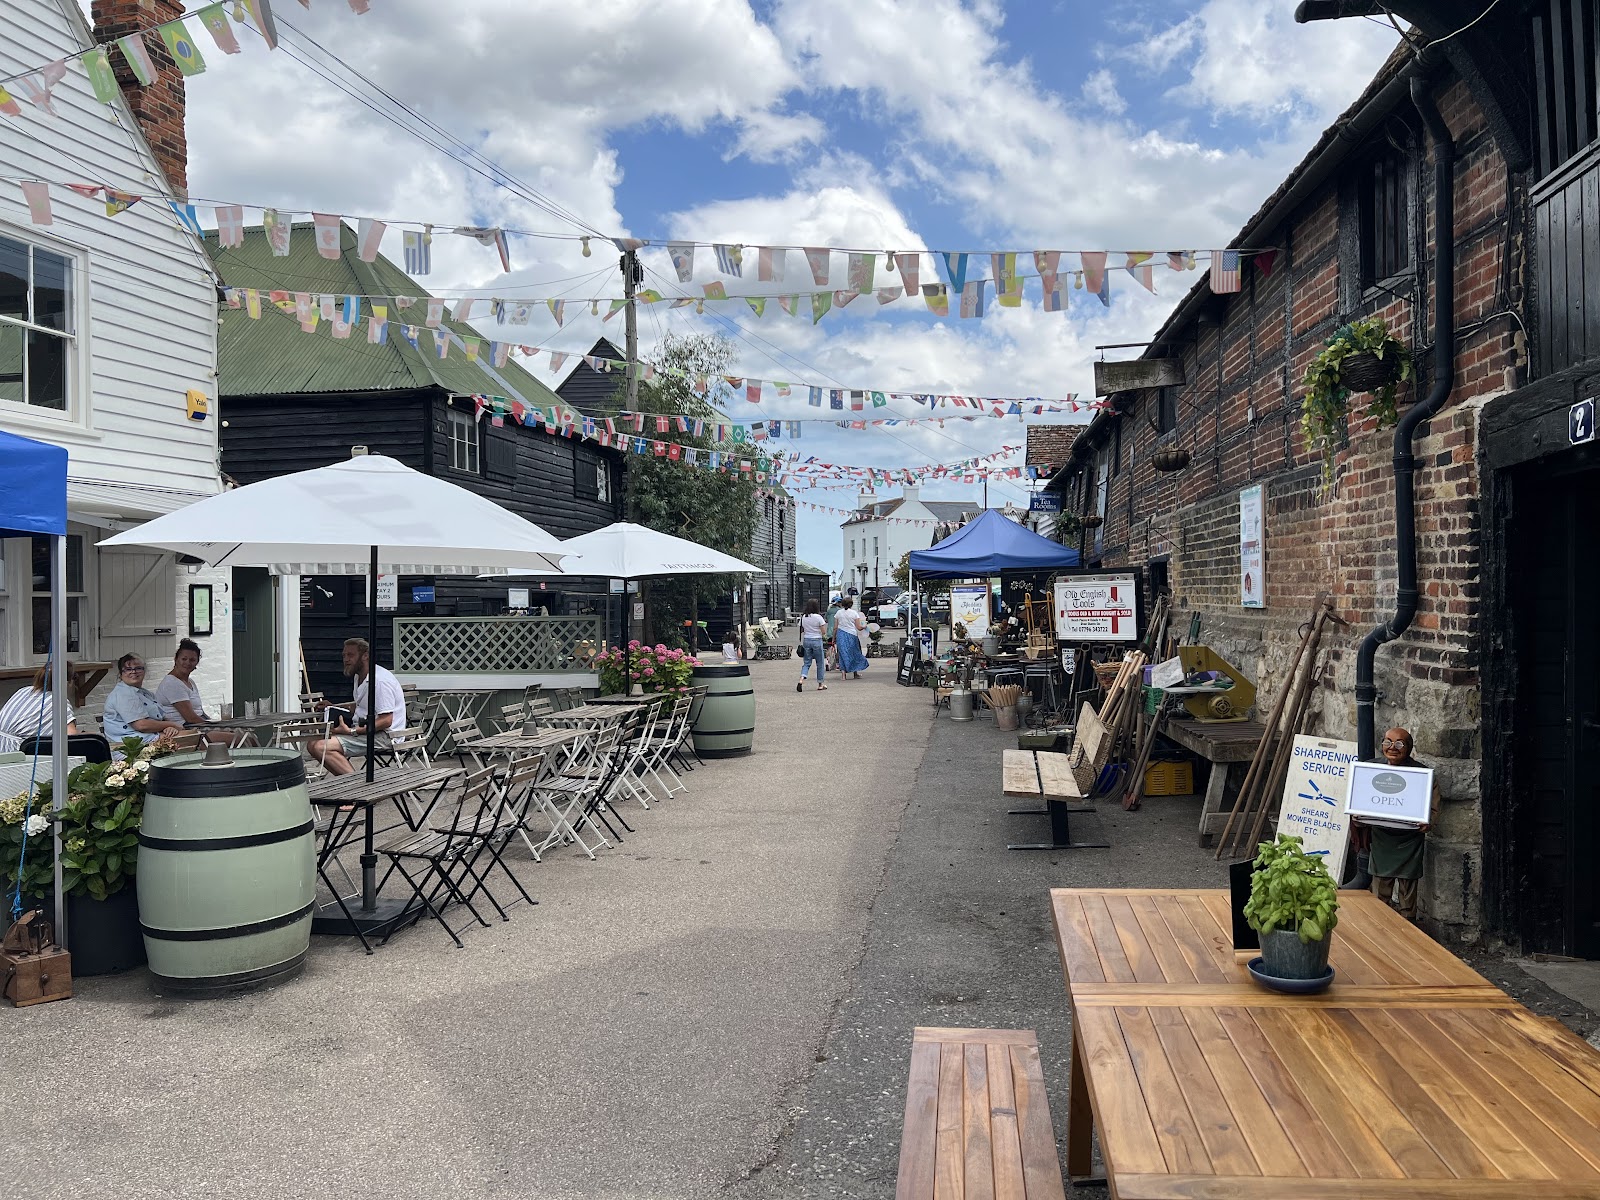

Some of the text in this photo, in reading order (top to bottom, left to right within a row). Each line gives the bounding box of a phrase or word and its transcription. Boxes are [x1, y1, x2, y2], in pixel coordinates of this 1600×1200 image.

[195, 398, 206, 406] Yale
[1576, 407, 1584, 437] 2
[1064, 589, 1107, 600] Old English
[1072, 598, 1095, 608] Tools
[1294, 746, 1359, 764] SHARPENING
[1302, 761, 1345, 777] SERVICE
[1371, 796, 1404, 806] OPEN
[1301, 807, 1329, 819] SHEARS
[1286, 813, 1341, 831] MOWER BLADES
[1304, 826, 1319, 836] ETC.
